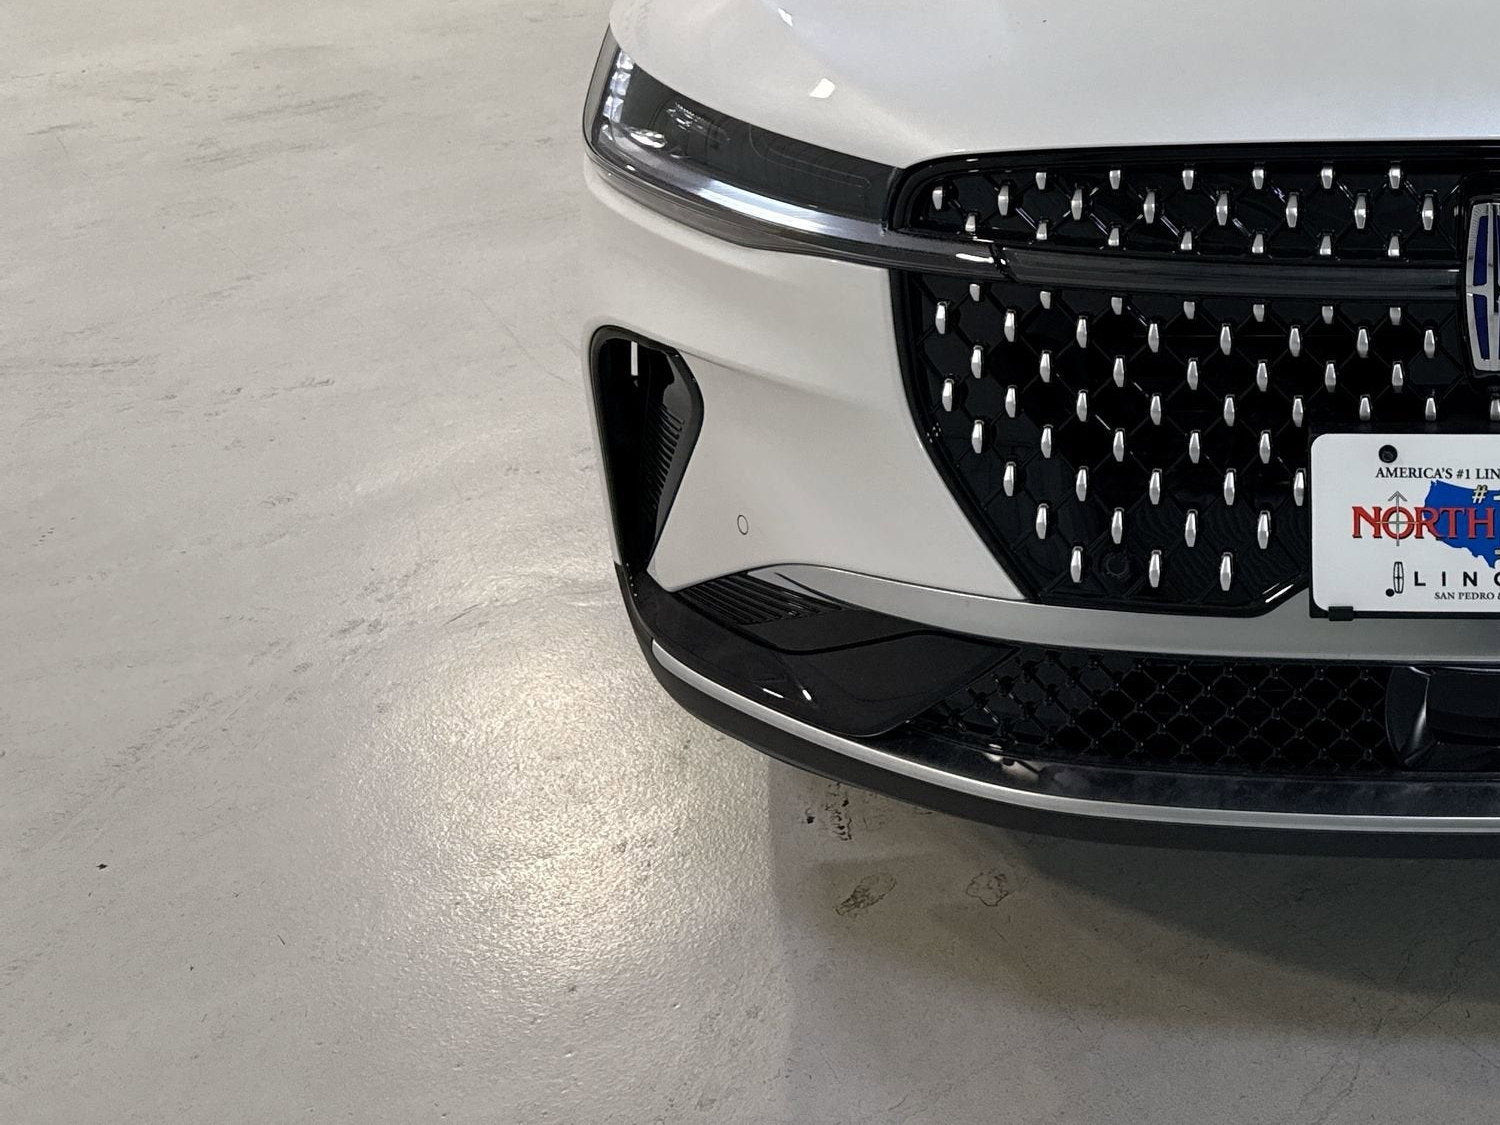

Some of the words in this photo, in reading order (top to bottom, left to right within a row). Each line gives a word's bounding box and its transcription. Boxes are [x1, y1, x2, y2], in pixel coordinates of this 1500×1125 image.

[1375, 466, 1453, 479] AMERICA'S
[1457, 468, 1470, 480] #1
[1351, 505, 1496, 539] NORTH
[1435, 591, 1456, 601] SAN
[1458, 591, 1495, 601] PEDRO
